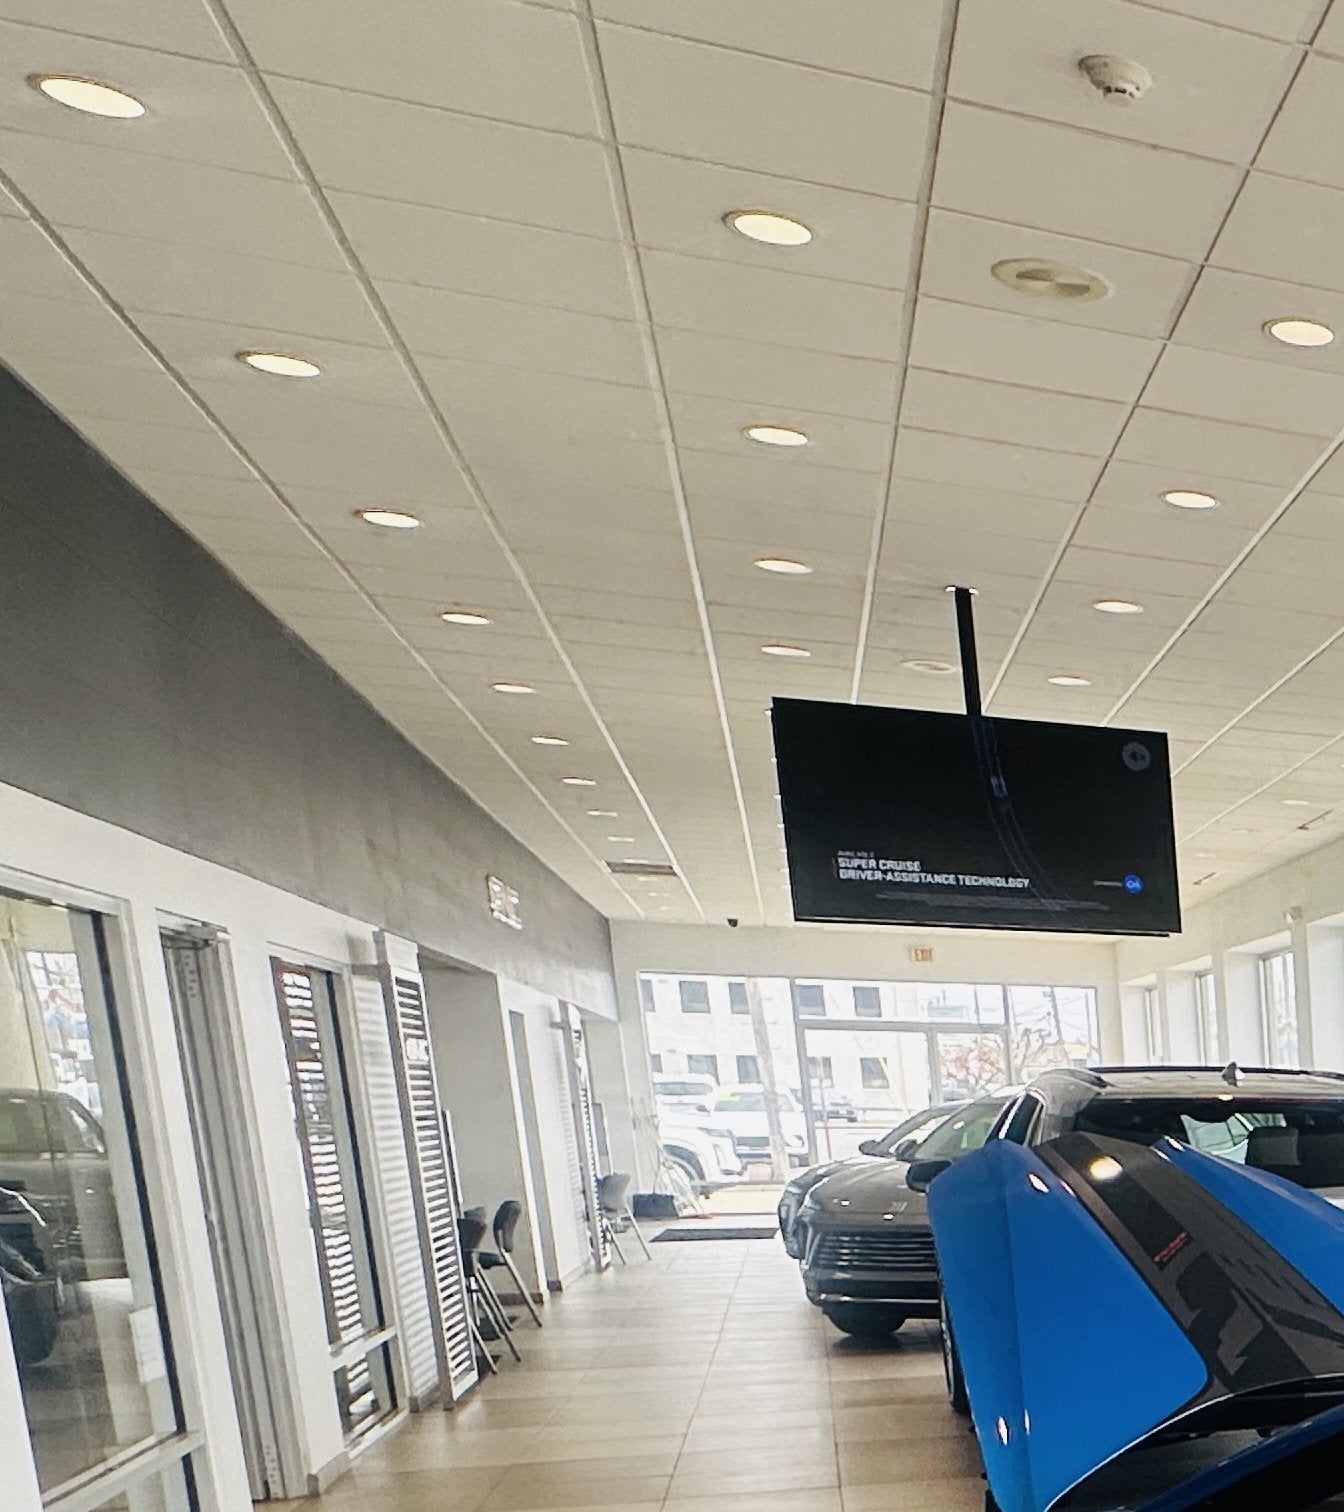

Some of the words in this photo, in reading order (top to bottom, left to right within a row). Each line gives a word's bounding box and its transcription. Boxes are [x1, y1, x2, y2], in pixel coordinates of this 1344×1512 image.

[837, 857, 877, 870] SUPER
[878, 859, 921, 872] CRUISE
[838, 868, 956, 885] DRIVER-ASSISTANCE
[958, 874, 1030, 889] TECHNOLOGY
